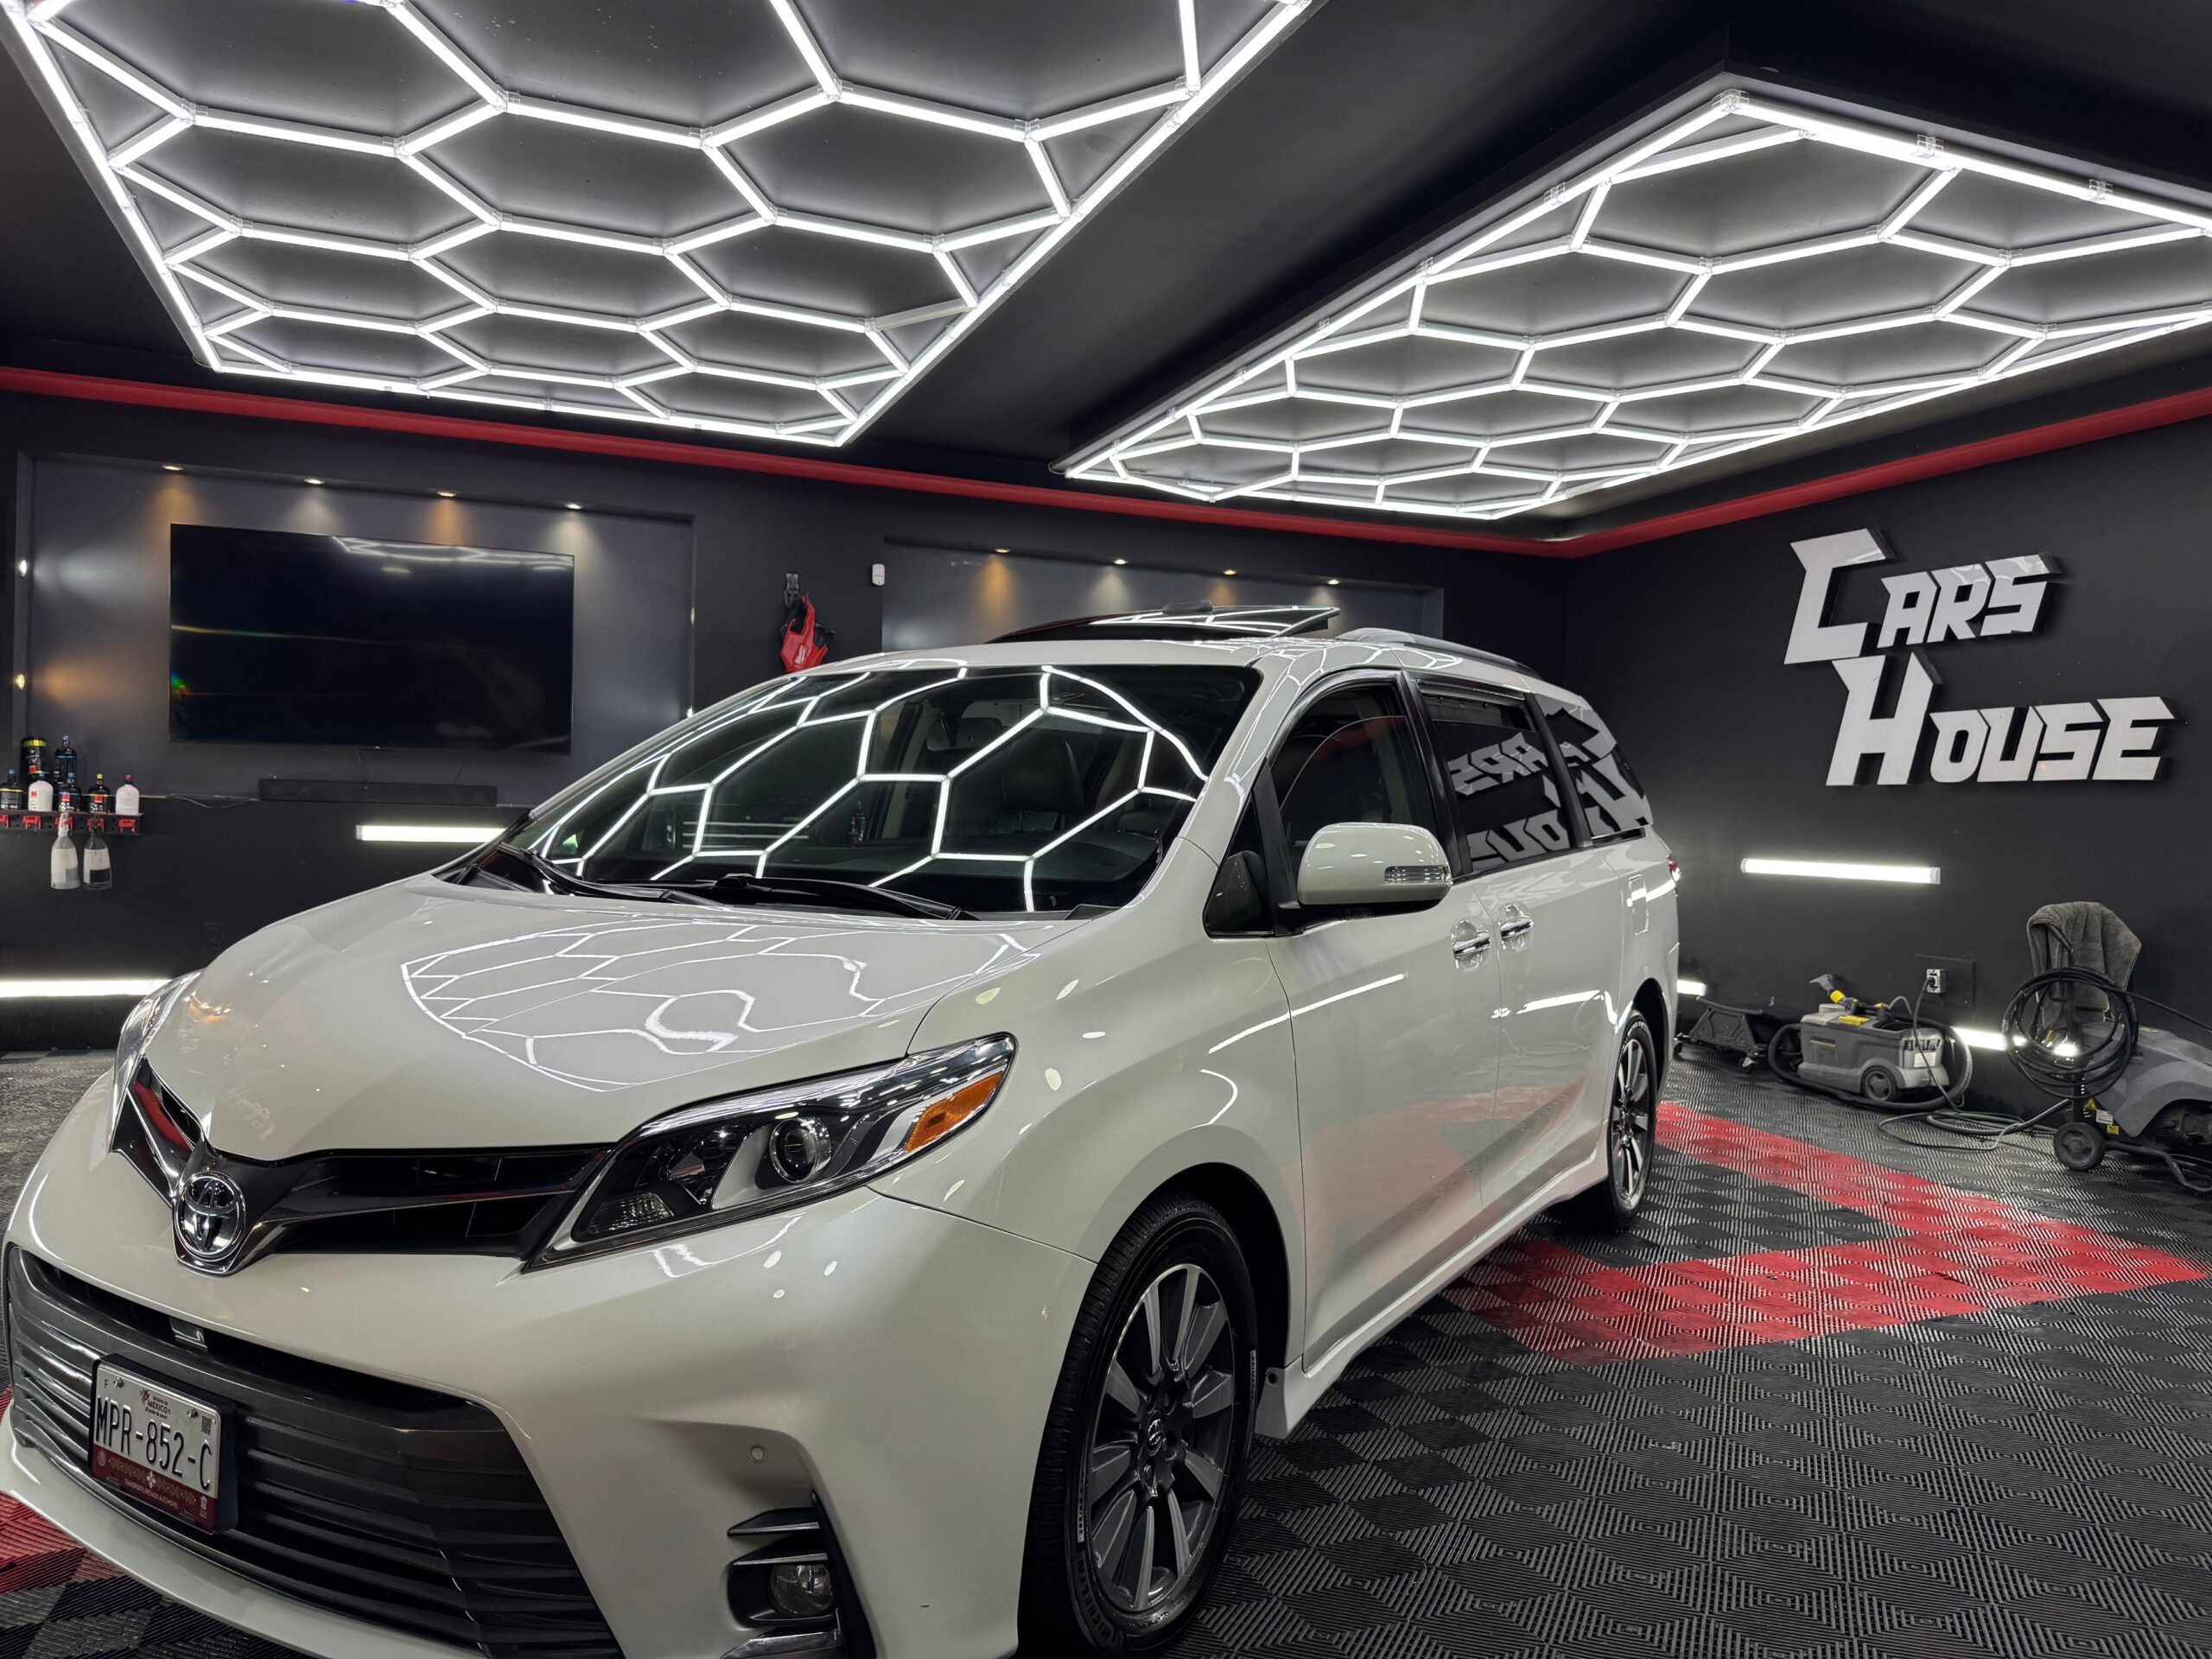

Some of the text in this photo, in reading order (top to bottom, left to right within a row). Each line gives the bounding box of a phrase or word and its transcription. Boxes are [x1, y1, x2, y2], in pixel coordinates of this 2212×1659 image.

[1784, 528, 2053, 664] CARS
[1826, 652, 2177, 785] HOUSE
[95, 1394, 213, 1491] MPR-852-C
[1077, 1559, 1113, 1641] MICHELIN
